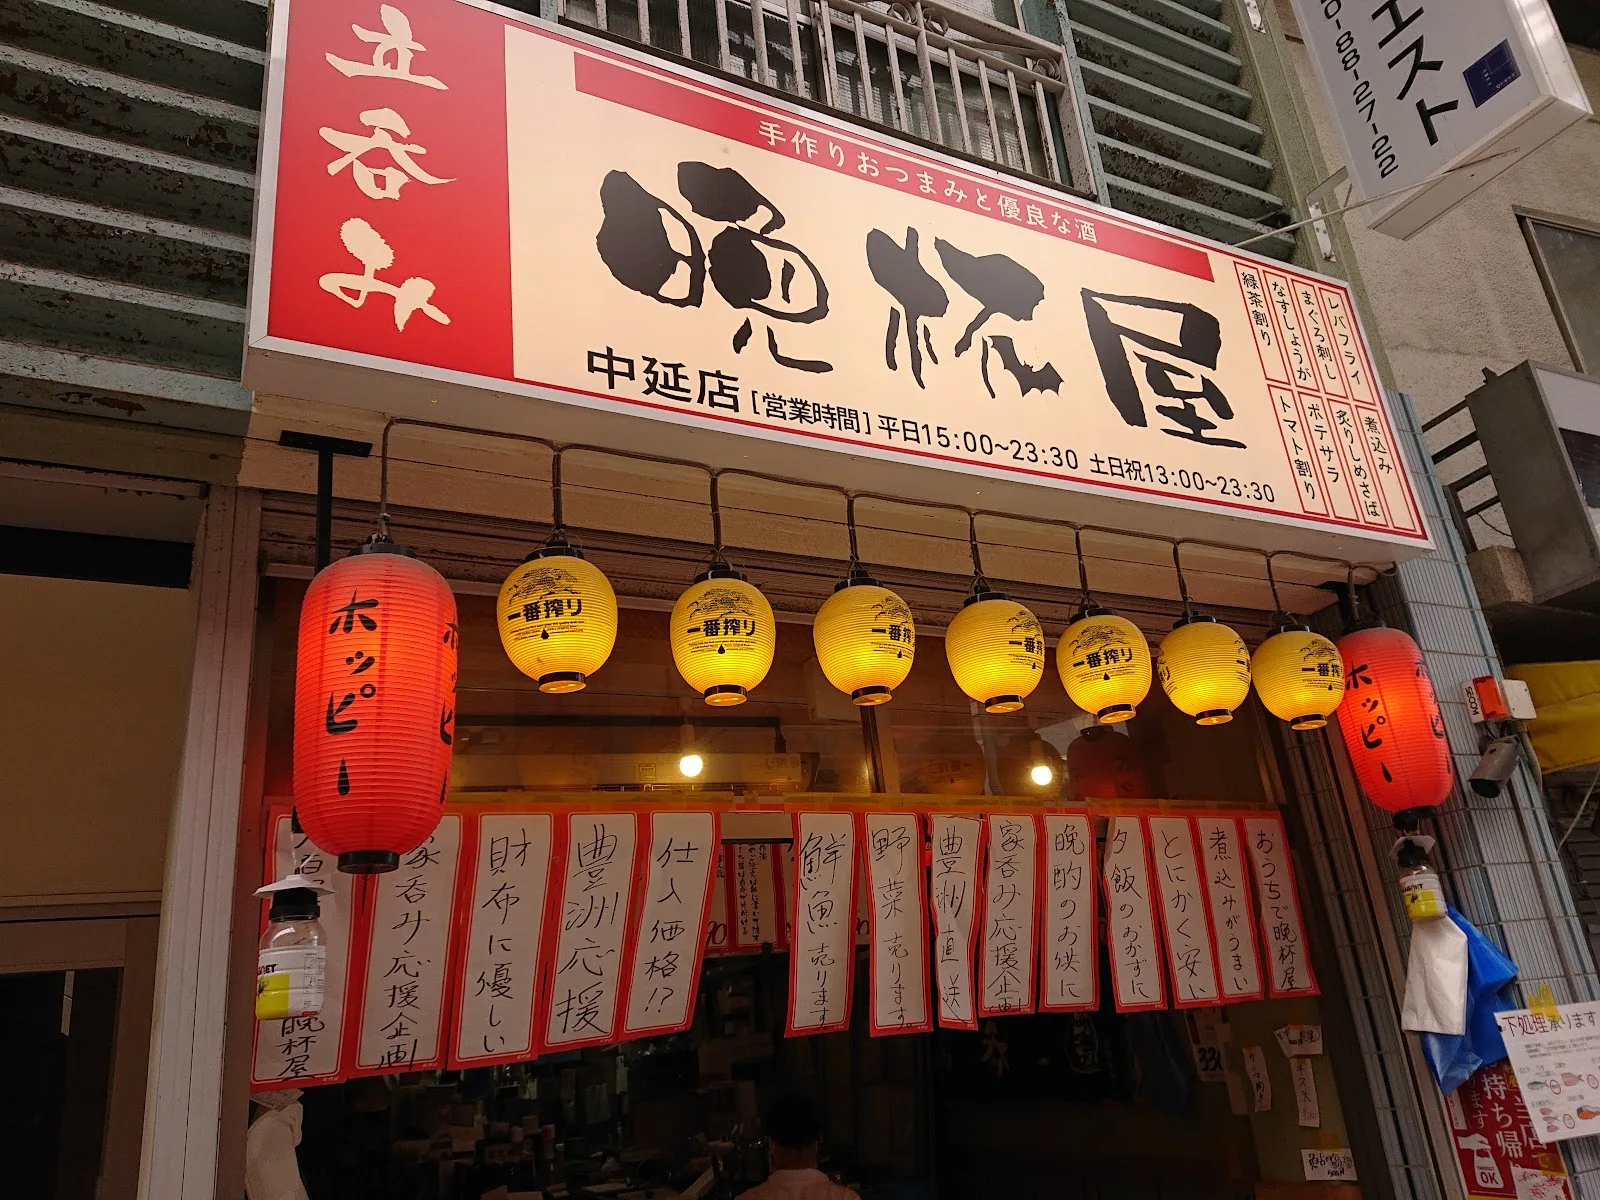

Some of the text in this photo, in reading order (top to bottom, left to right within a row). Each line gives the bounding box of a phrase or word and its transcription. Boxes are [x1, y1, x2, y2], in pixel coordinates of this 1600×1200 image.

[1320, 0, 1399, 179] 0-88-27-22
[318, 4, 457, 333] 立呑み
[758, 120, 1098, 244] 手作りおつまみと優良な酒
[1241, 272, 1272, 346] 緑茶割り
[1272, 281, 1312, 381] なすしょうが
[1301, 290, 1337, 380] まぐろ刺し
[1327, 297, 1361, 385] レバフライ
[587, 345, 740, 413] 中延店
[751, 389, 871, 435] [営業時間]
[1308, 403, 1340, 483] ポテサラ
[1279, 395, 1316, 500] トマト割り
[1336, 409, 1381, 517] 炙りしめさば
[1365, 416, 1393, 475] 煮込み
[507, 598, 582, 622] 一番搾り
[687, 618, 757, 637] 一番搾り
[871, 624, 915, 647] 一番搾
[1073, 647, 1134, 669] 一番搾り
[326, 588, 380, 797] ホッピー
[1301, 663, 1344, 678] 一番搾
[1345, 661, 1393, 783] ホッピー
[475, 828, 532, 1053] 財布に優しい
[555, 823, 619, 1035] 豊洲応援
[936, 825, 972, 1023] 豊洲直送
[987, 819, 1025, 1013] 家呑み応援企画
[1053, 824, 1085, 998] 晩酌のお供に
[1110, 828, 1150, 999] 夕飯のおかずに
[1161, 830, 1206, 999] とにかく安い
[1209, 826, 1248, 991] 煮込みがうまい
[1256, 829, 1301, 992] おうちで晩杯屋
[1480, 1170, 1497, 1185] OK
